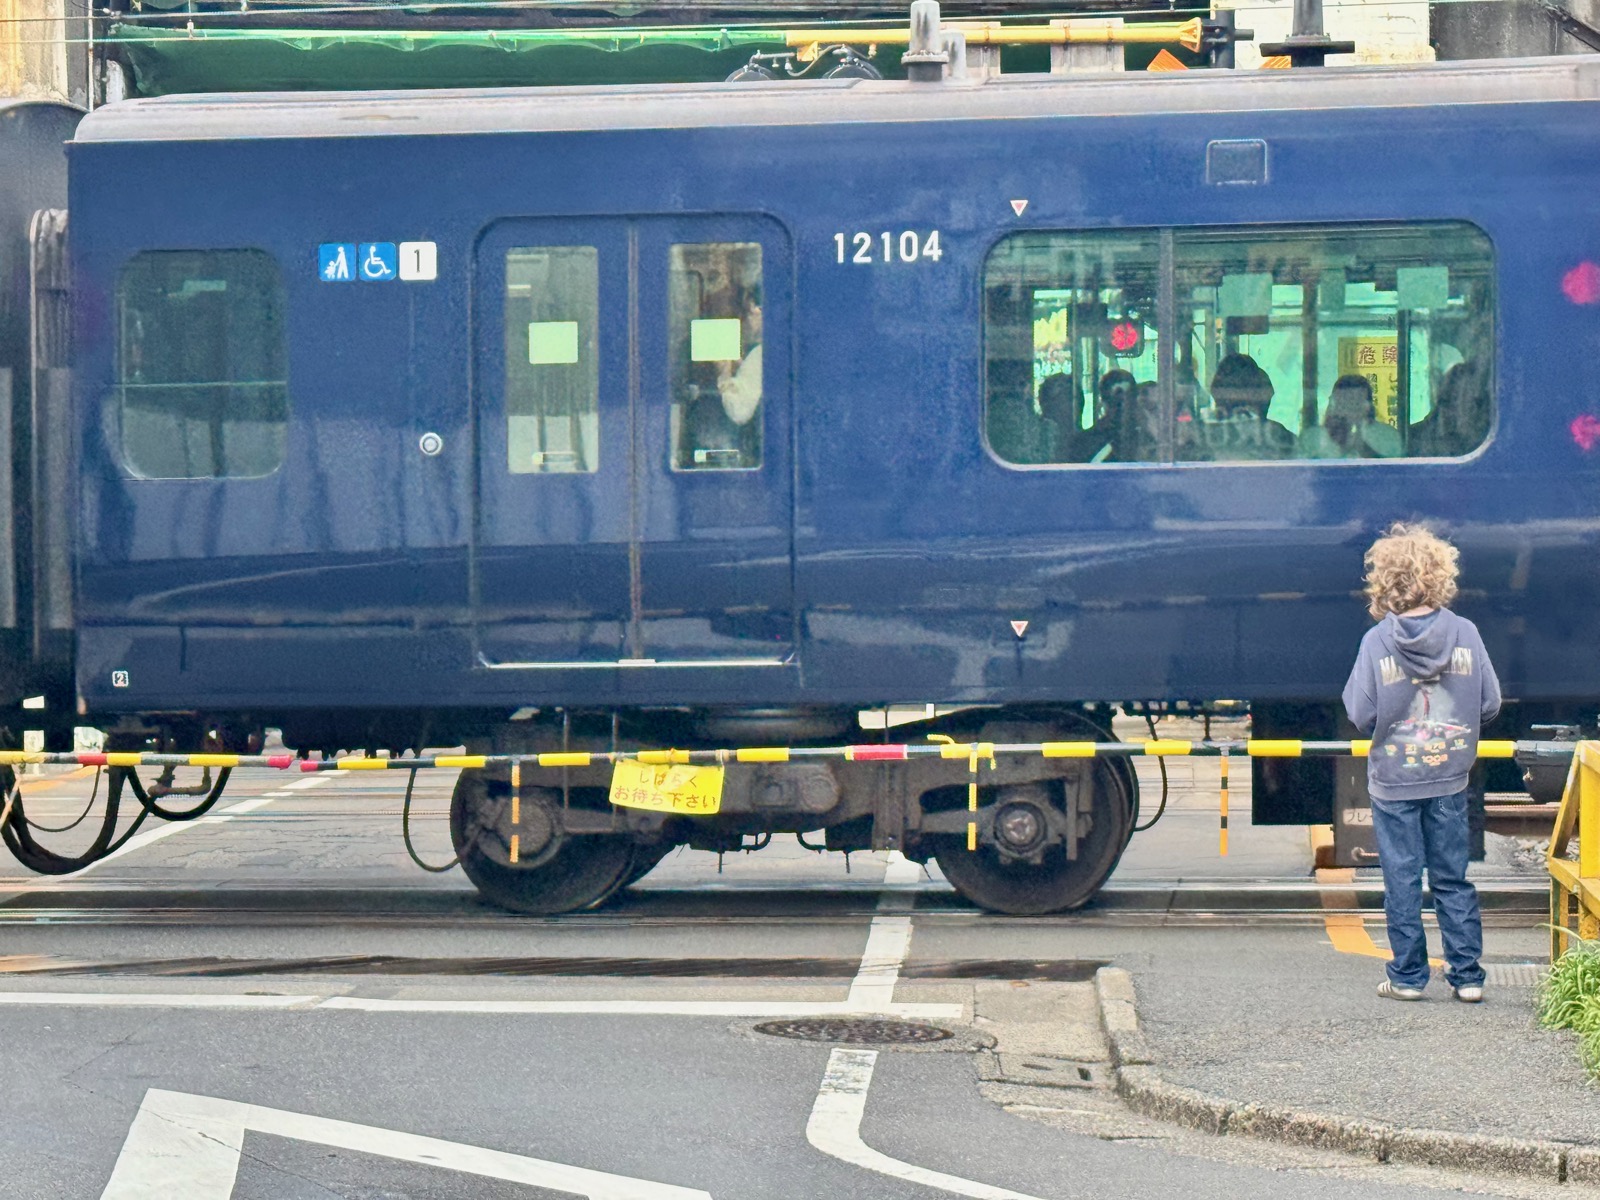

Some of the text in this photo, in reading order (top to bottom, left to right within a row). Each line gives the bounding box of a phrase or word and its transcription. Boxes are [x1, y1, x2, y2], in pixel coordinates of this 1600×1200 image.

[833, 230, 942, 263] 12104
[414, 249, 420, 273] 1
[640, 770, 697, 788] しばらく
[614, 785, 716, 808] お待ち下さい
